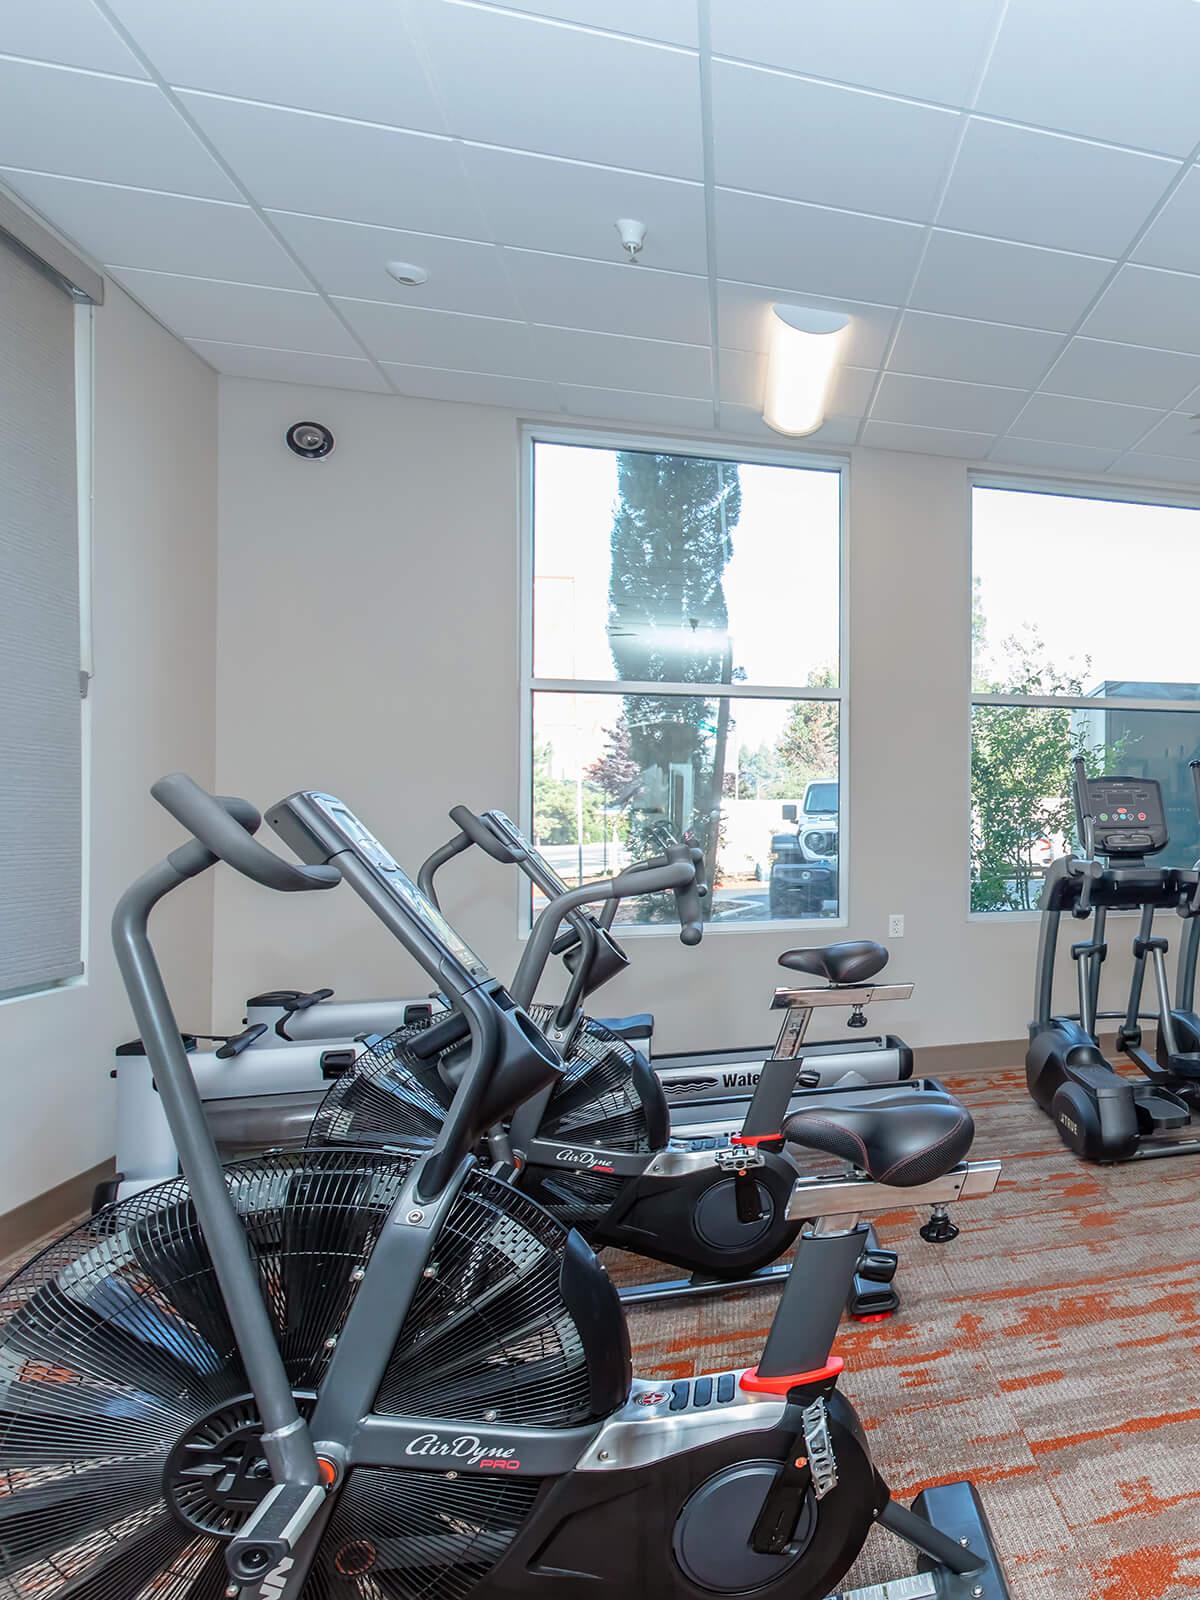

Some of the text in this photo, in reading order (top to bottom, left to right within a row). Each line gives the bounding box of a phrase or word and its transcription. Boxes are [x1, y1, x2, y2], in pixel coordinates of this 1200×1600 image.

[556, 1149, 613, 1168] AirDyne
[405, 1434, 516, 1465] AirDyne
[480, 1459, 521, 1470] PRO
